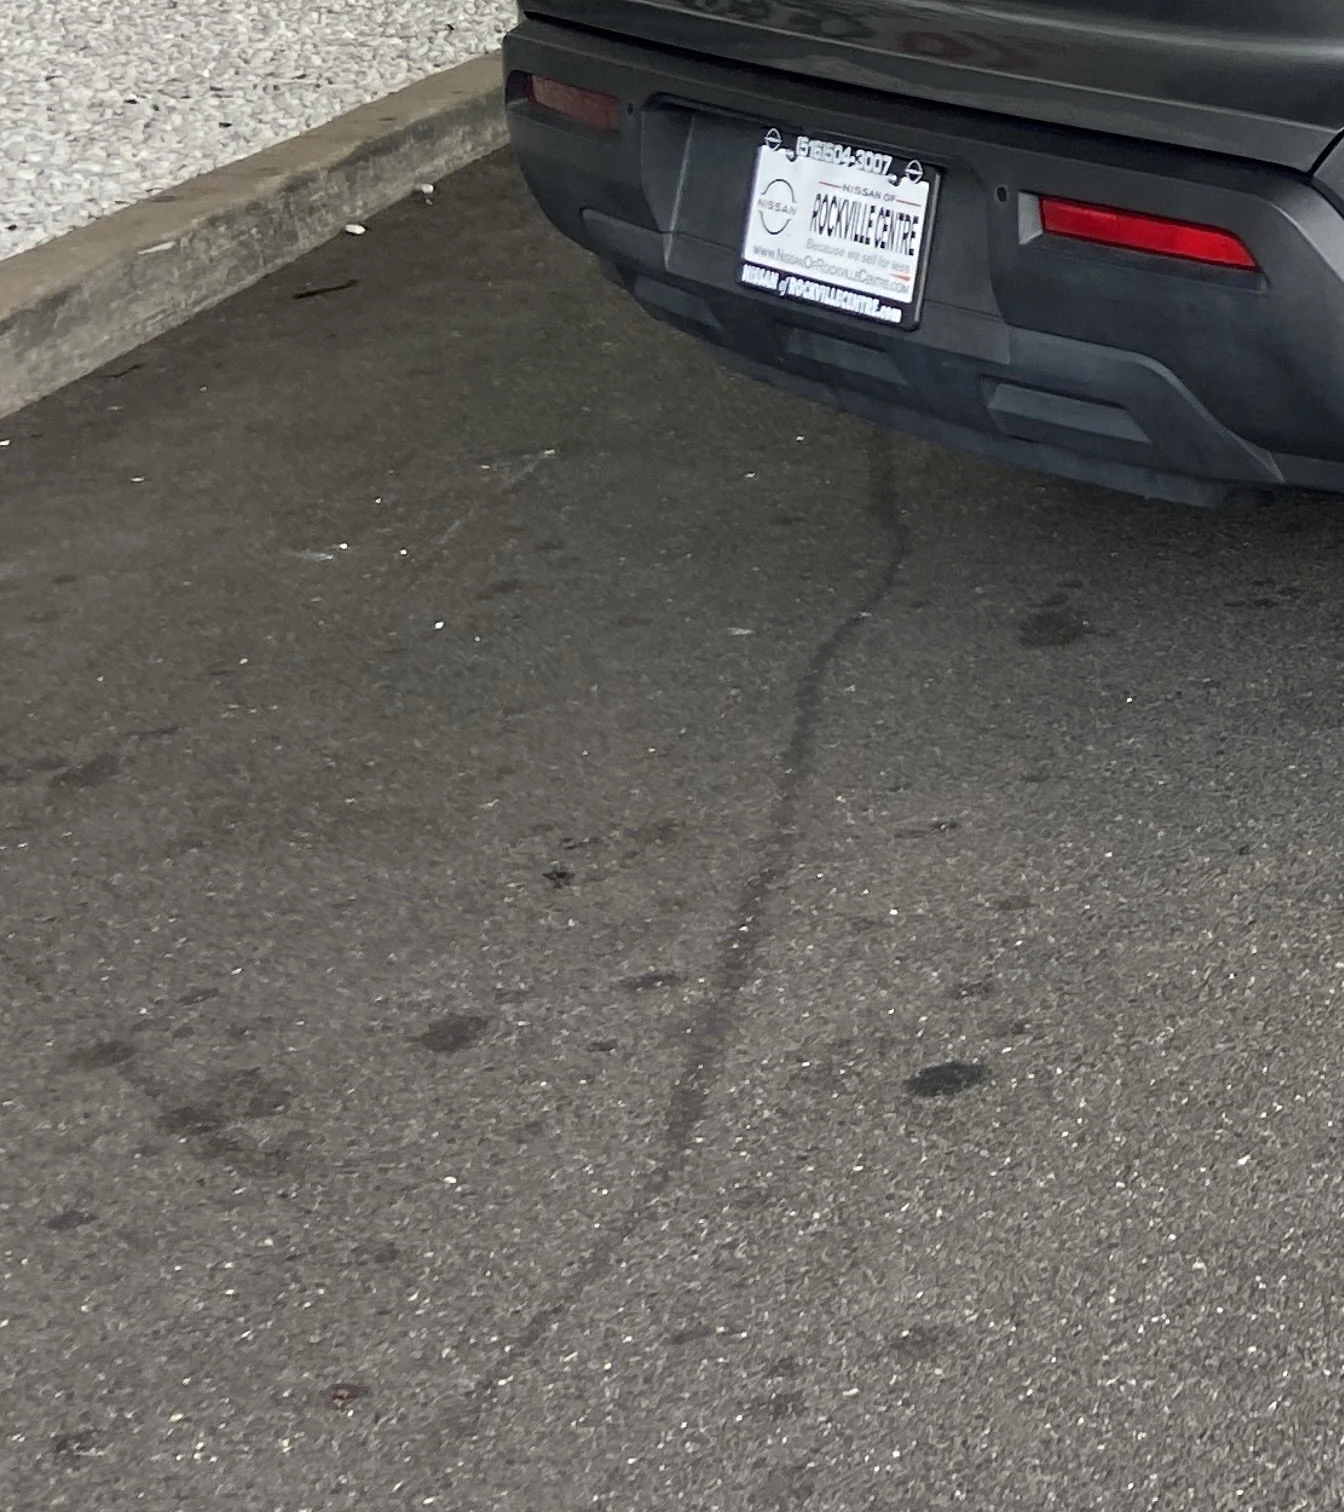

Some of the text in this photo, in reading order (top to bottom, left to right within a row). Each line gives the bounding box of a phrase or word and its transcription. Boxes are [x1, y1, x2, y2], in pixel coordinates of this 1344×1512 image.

[758, 199, 797, 215] NISSAN
[811, 193, 920, 257] ROCKVILLE CENTRE
